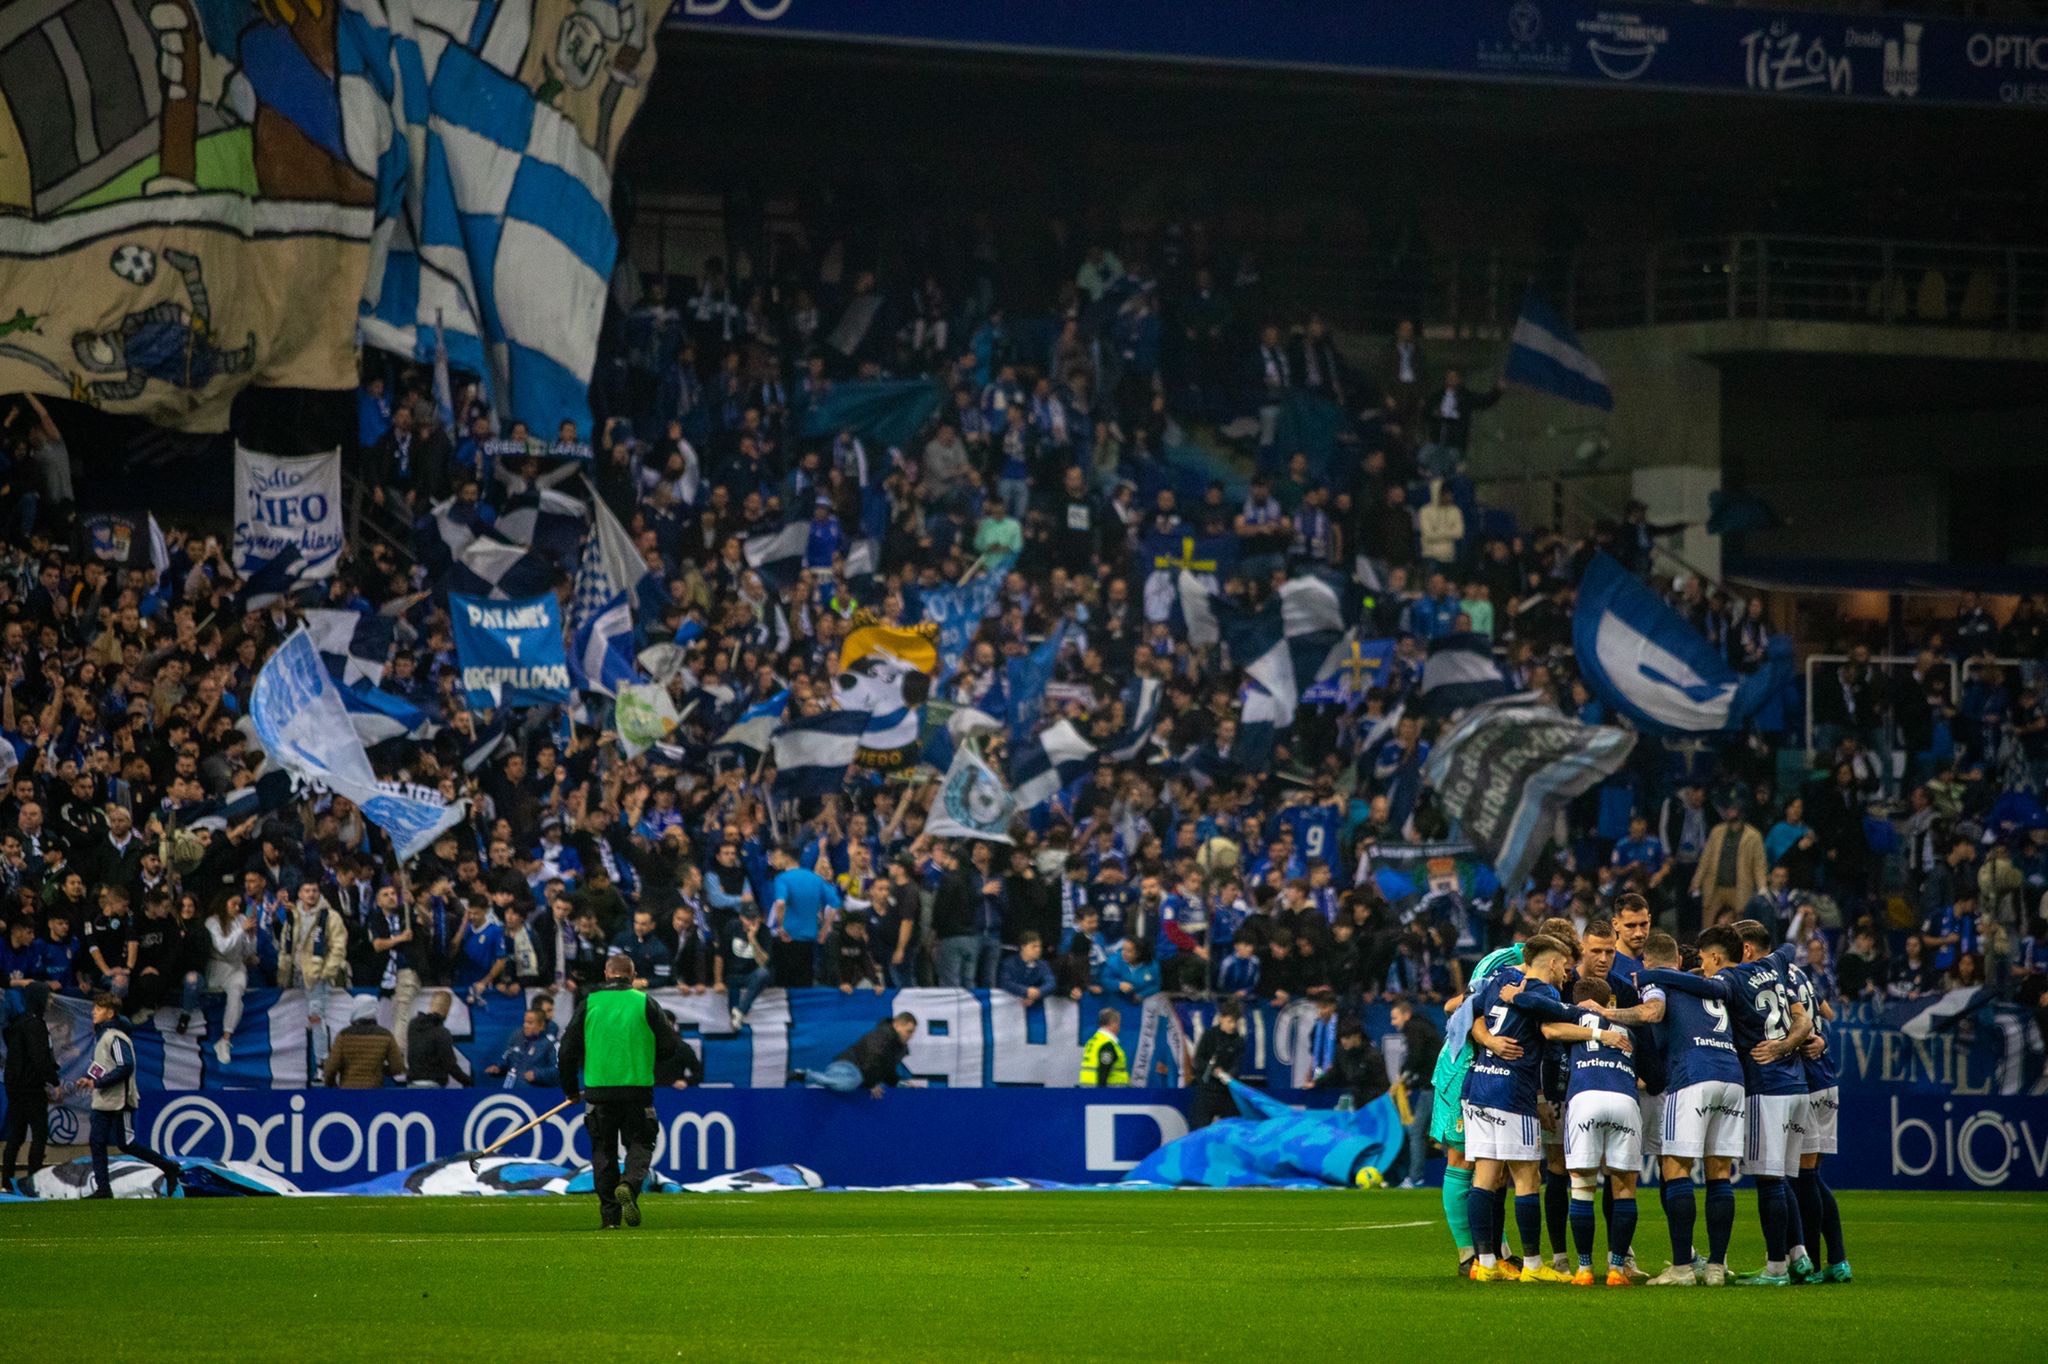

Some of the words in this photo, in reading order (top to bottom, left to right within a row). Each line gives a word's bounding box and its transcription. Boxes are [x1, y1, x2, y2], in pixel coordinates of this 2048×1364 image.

[248, 490, 328, 528] TIFO
[505, 635, 522, 659] Y
[1305, 825, 1325, 857] 9
[1702, 998, 1729, 1034] 9
[1693, 1036, 1730, 1051] Tartiere
[1576, 1057, 1615, 1070] Tartiere
[151, 1095, 435, 1172] exiom
[464, 1094, 736, 1171] exm
